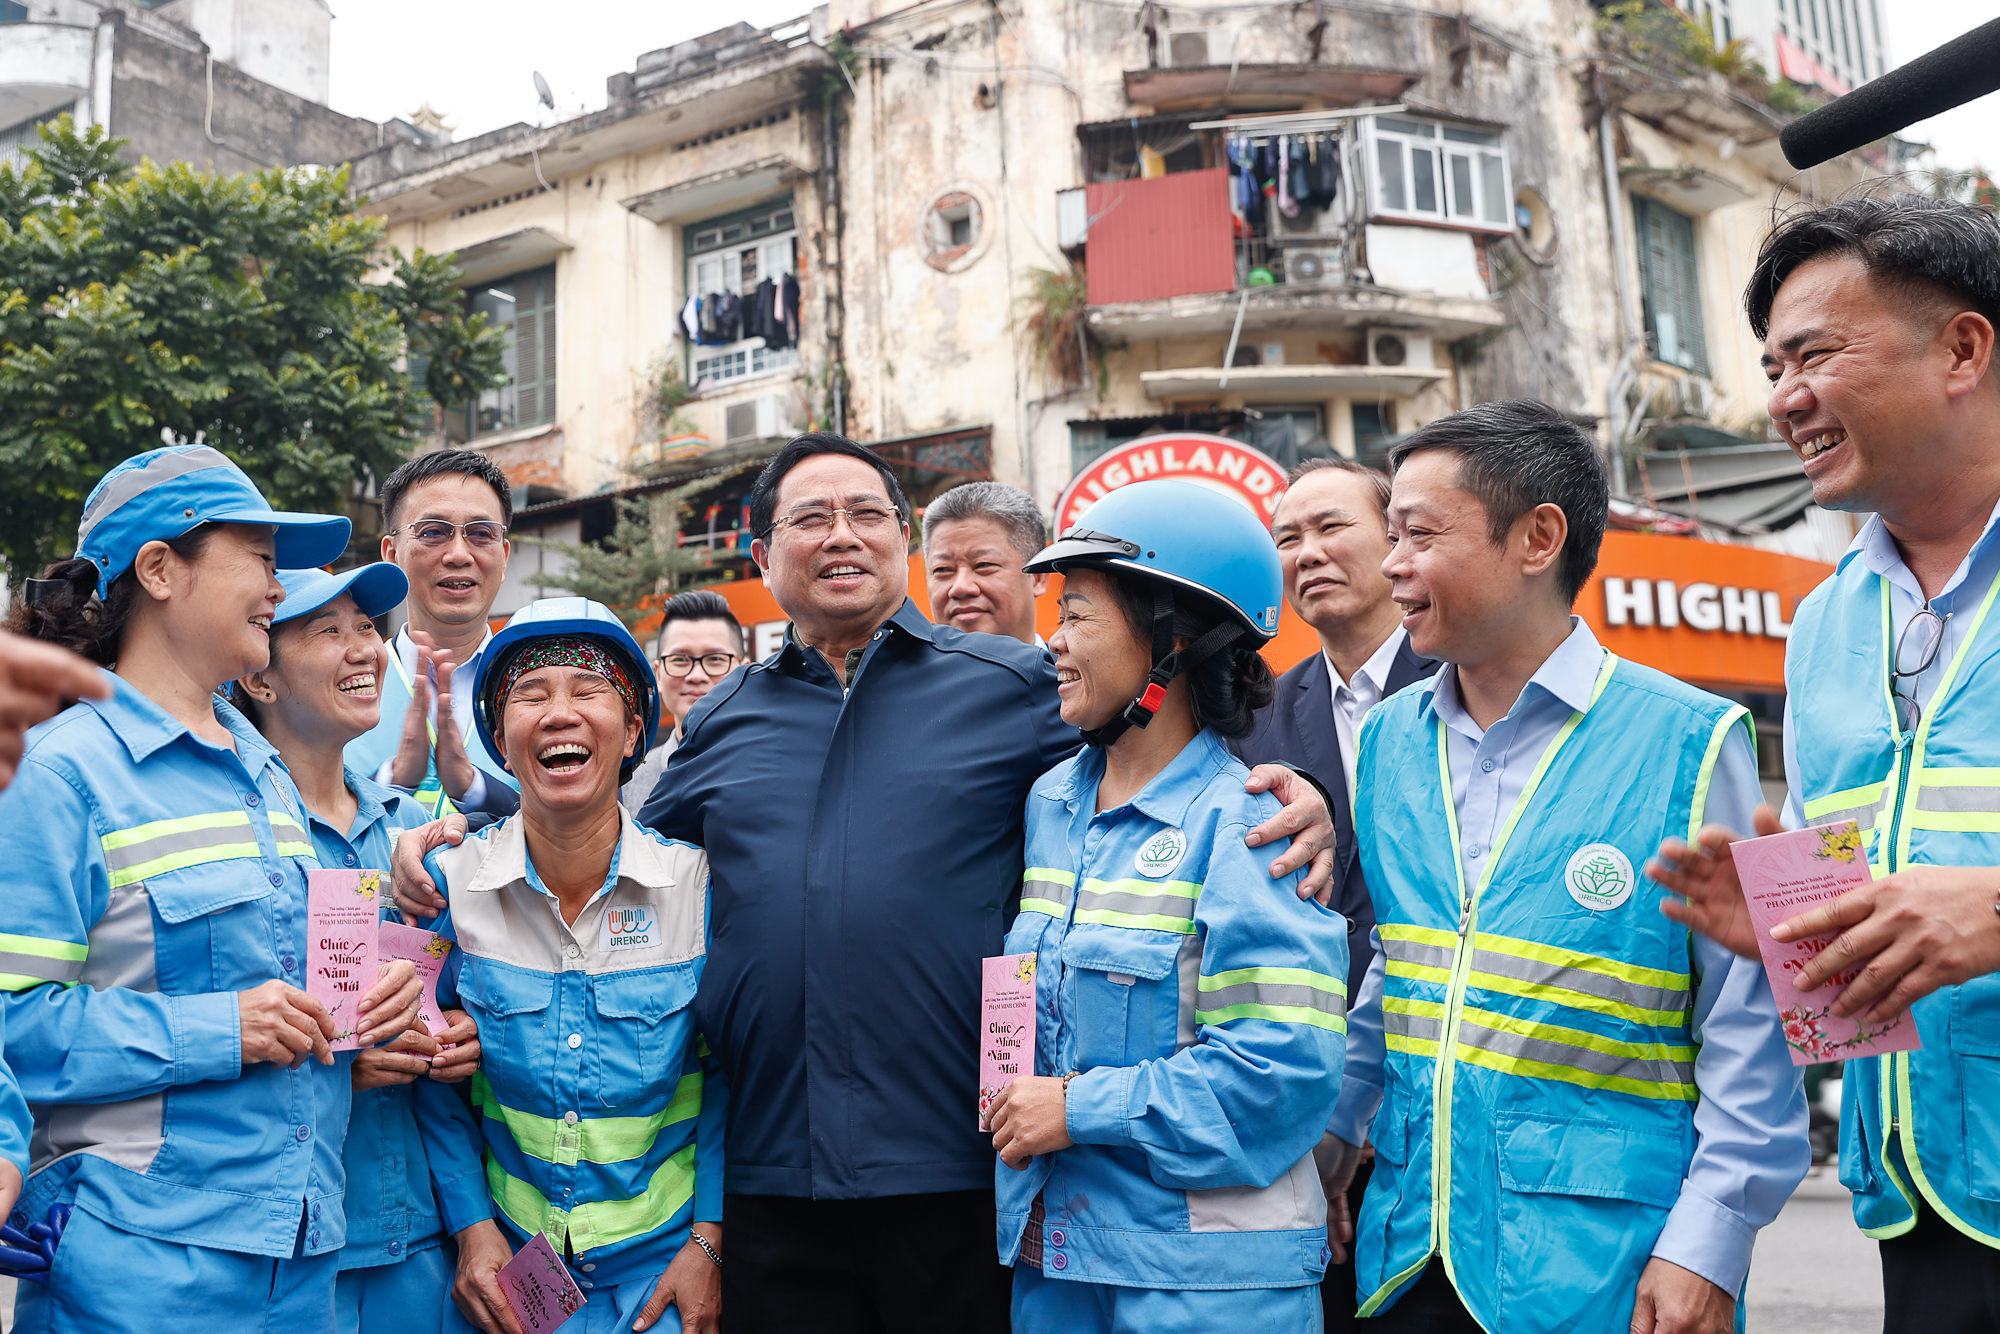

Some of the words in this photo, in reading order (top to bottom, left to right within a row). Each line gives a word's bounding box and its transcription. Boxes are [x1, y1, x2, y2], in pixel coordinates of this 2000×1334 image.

[1604, 577, 1790, 639] HIGHL
[1578, 893, 1612, 905] URENCO
[1765, 898, 1794, 909] PHẠM
[1796, 893, 1822, 904] MINH
[320, 937, 350, 950] Chúc
[610, 934, 649, 946] URENCO
[329, 948, 365, 967] Mừng
[318, 966, 349, 979] Năm
[333, 980, 359, 992] Mới
[989, 1021, 1011, 1034] Chúc
[988, 1050, 1010, 1061] Năm
[998, 1063, 1018, 1074] Mới
